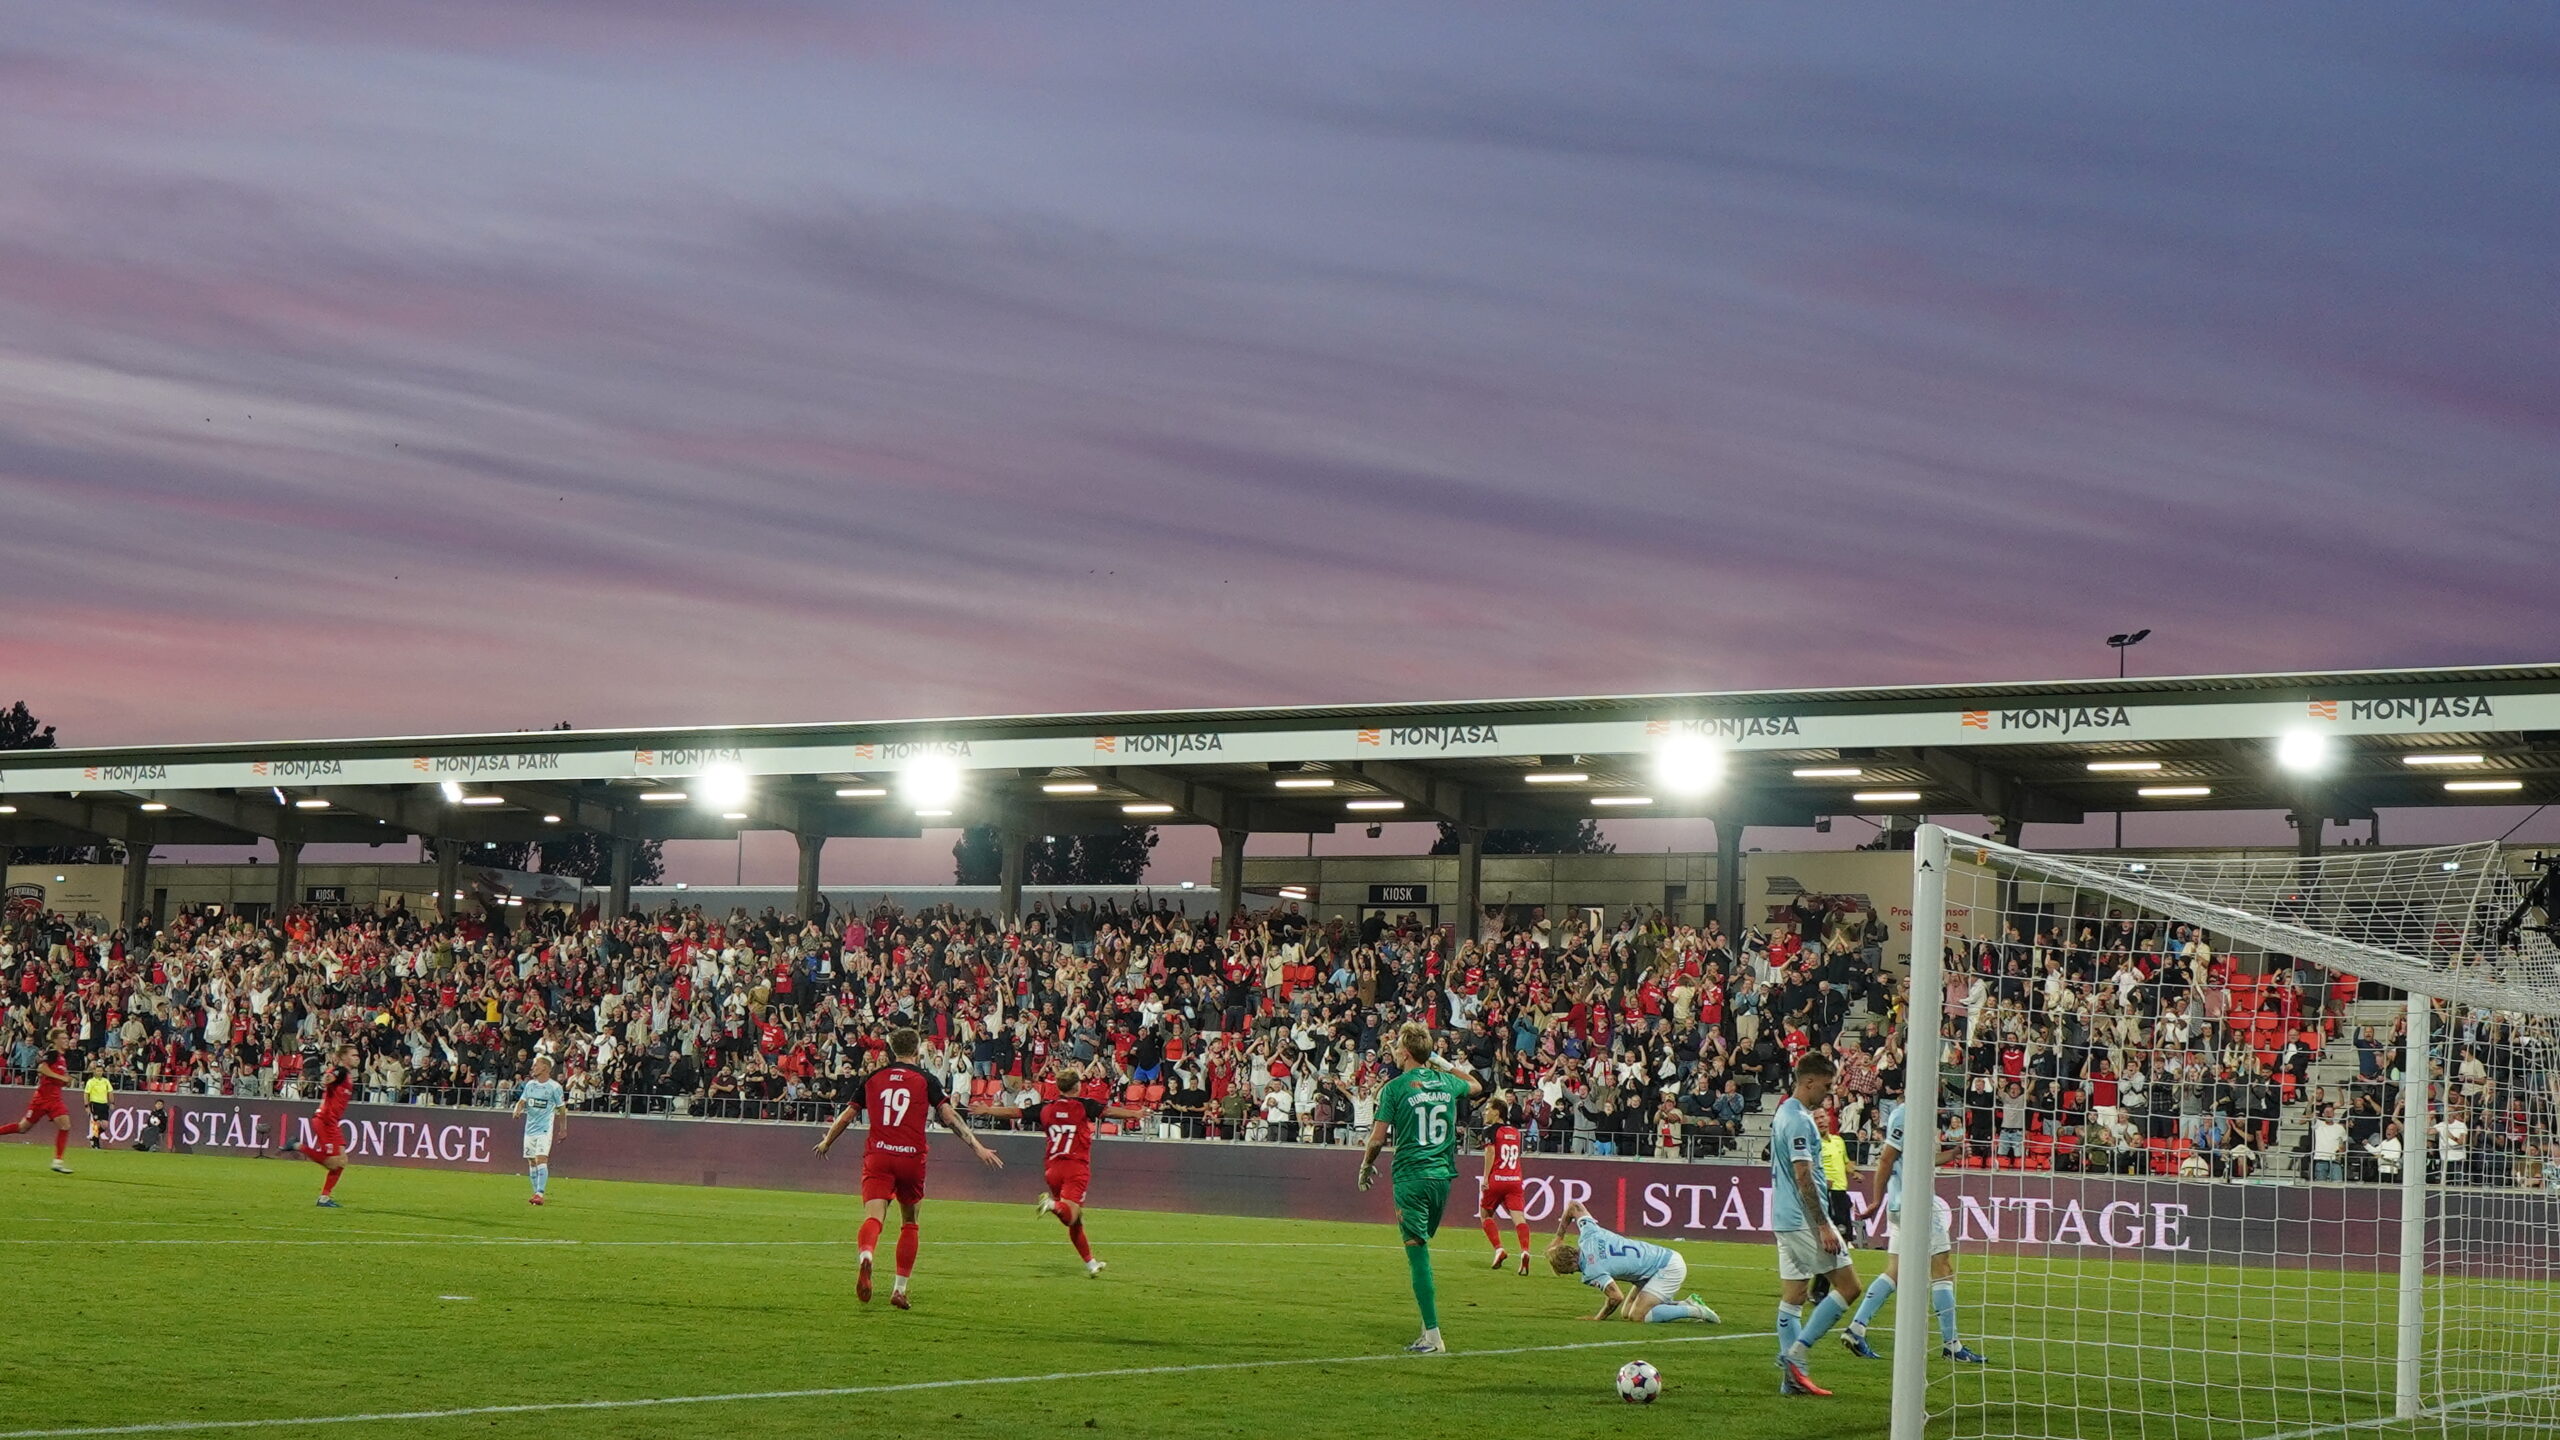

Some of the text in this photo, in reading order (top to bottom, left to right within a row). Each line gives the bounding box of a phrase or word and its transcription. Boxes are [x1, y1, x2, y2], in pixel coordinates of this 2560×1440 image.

[2001, 705, 2131, 735] MONJASA
[2352, 695, 2493, 725] MONJASA
[1391, 724, 1498, 751] MONJASA
[1682, 715, 1800, 743] MONJASA
[1124, 732, 1223, 758] MONJASA
[103, 765, 167, 784] MONJASA
[273, 760, 342, 779] MONJASA
[436, 753, 559, 776] MONJASA PARK
[315, 889, 336, 901] KIOSK
[1383, 887, 1413, 901] KIOSK
[880, 1088, 911, 1127] 19
[182, 1105, 270, 1149] STÅL
[1414, 1104, 1448, 1146] 16
[1499, 1143, 1519, 1170] 98
[1846, 1190, 2190, 1251] MNTAGE
[1609, 1244, 1641, 1259] 5
